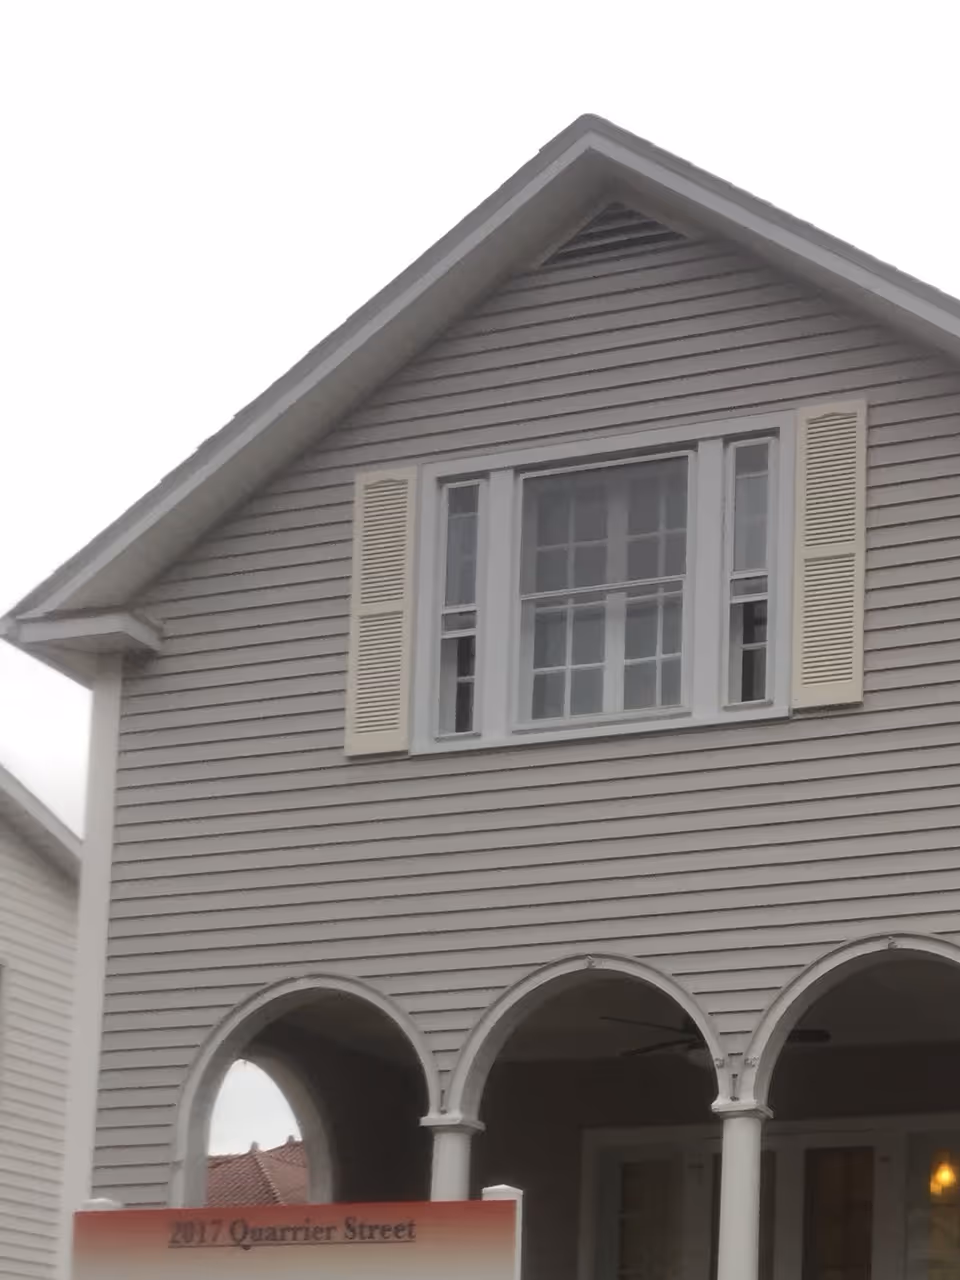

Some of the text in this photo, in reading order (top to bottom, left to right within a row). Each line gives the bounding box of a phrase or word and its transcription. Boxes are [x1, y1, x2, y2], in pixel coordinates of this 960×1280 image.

[170, 1215, 417, 1250] 2017 Quarrier Street
